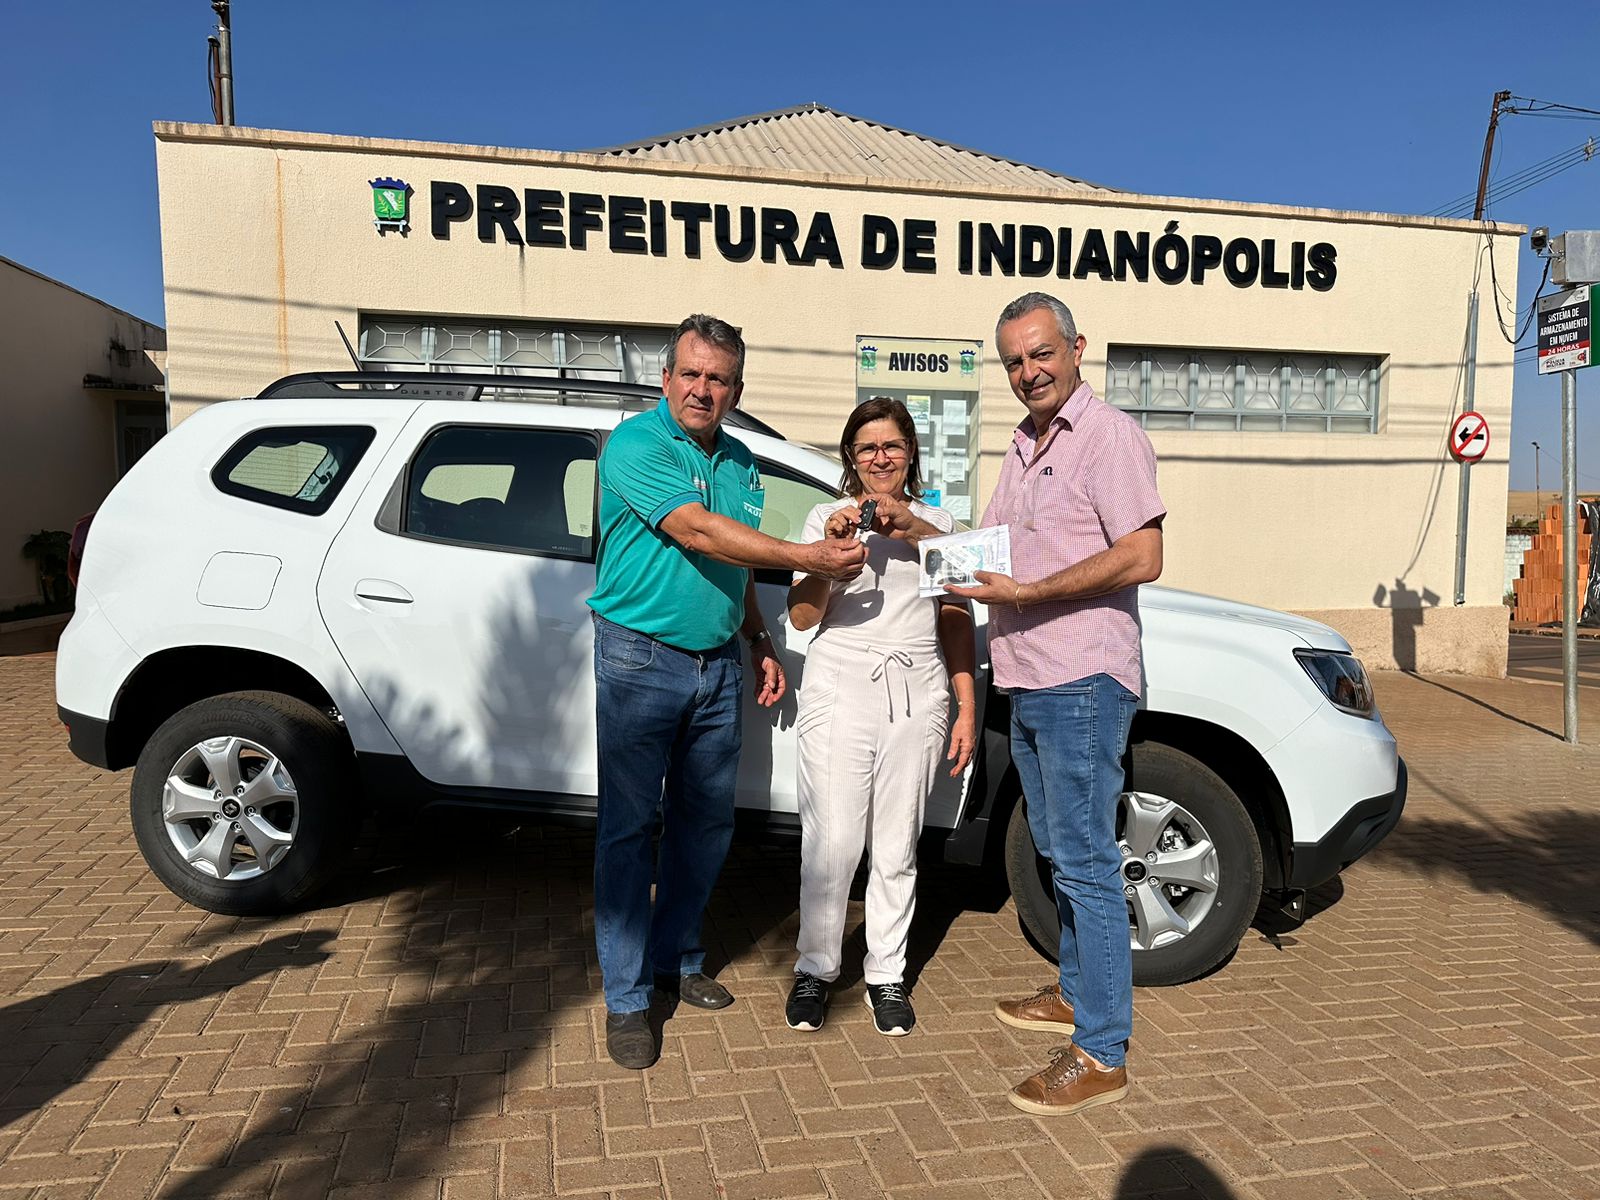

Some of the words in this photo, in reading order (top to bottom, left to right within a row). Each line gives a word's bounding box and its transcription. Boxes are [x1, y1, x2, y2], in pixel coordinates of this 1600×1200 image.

[430, 180, 844, 269] PREFEITURA
[861, 214, 937, 274] DE
[958, 220, 1338, 291] INDIANÓPOLIS
[1547, 310, 1571, 323] SISTEMA
[1571, 307, 1580, 318] DE
[1540, 317, 1588, 337] ARMAZENAMENTO
[1549, 336, 1558, 346] EM
[1558, 331, 1578, 345] NUVEM
[1557, 343, 1580, 353] HORAS
[888, 352, 949, 373] AVISOS
[401, 389, 465, 397] DUSTER
